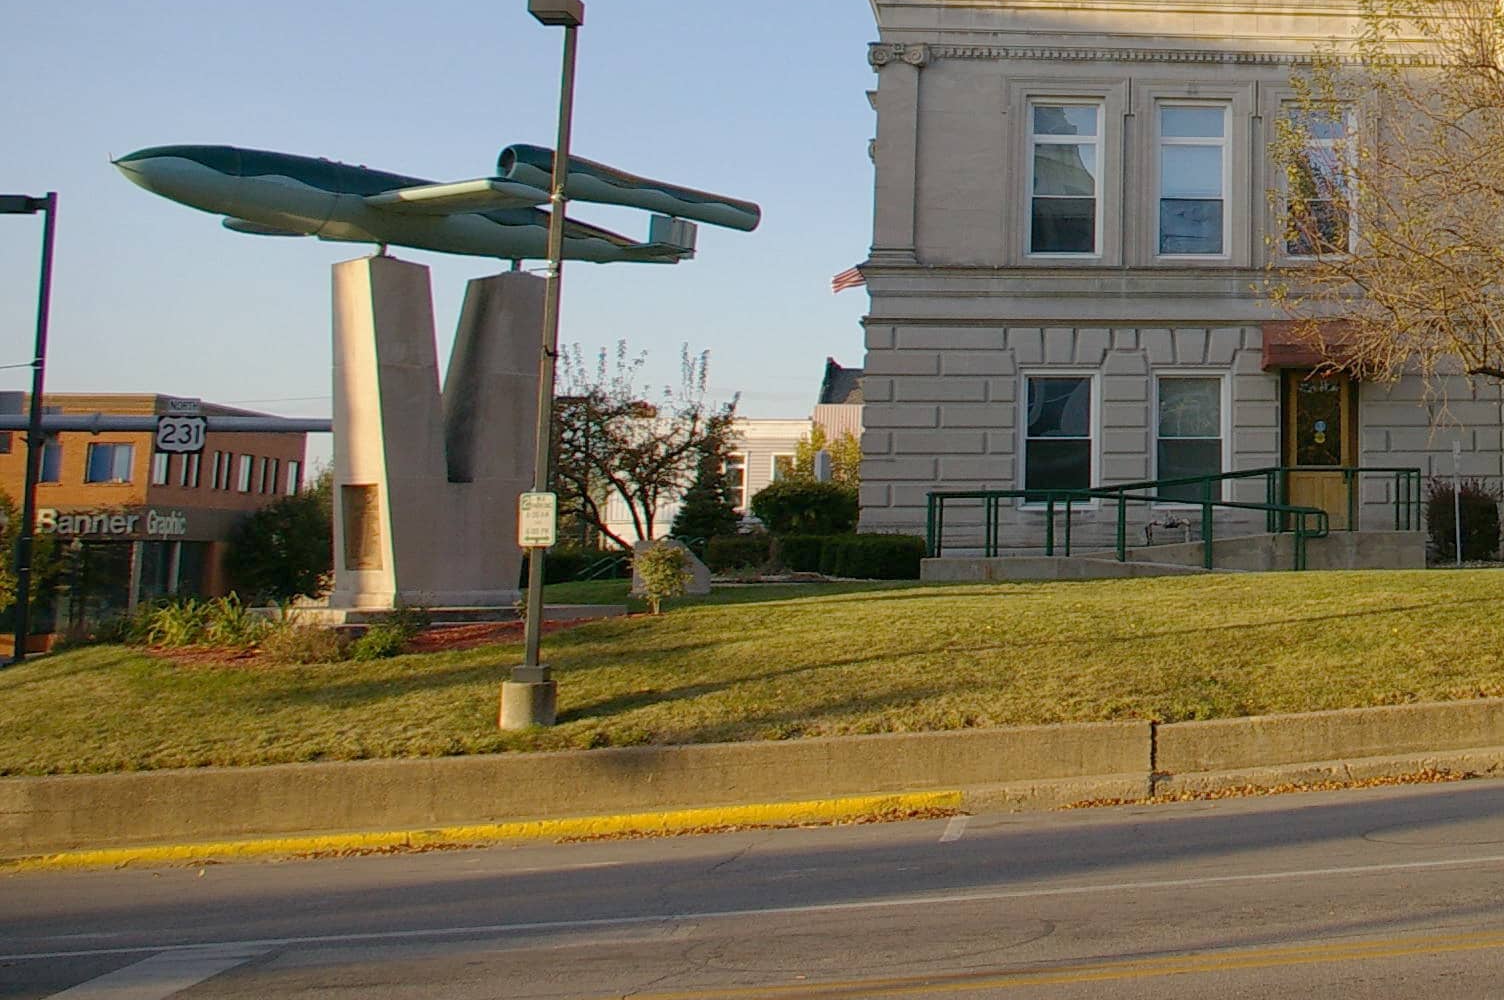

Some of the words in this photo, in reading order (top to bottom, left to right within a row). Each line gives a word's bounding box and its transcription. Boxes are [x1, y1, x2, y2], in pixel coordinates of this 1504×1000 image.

[161, 423, 200, 445] 231
[35, 508, 139, 534] Banner
[147, 509, 187, 541] Graphic
